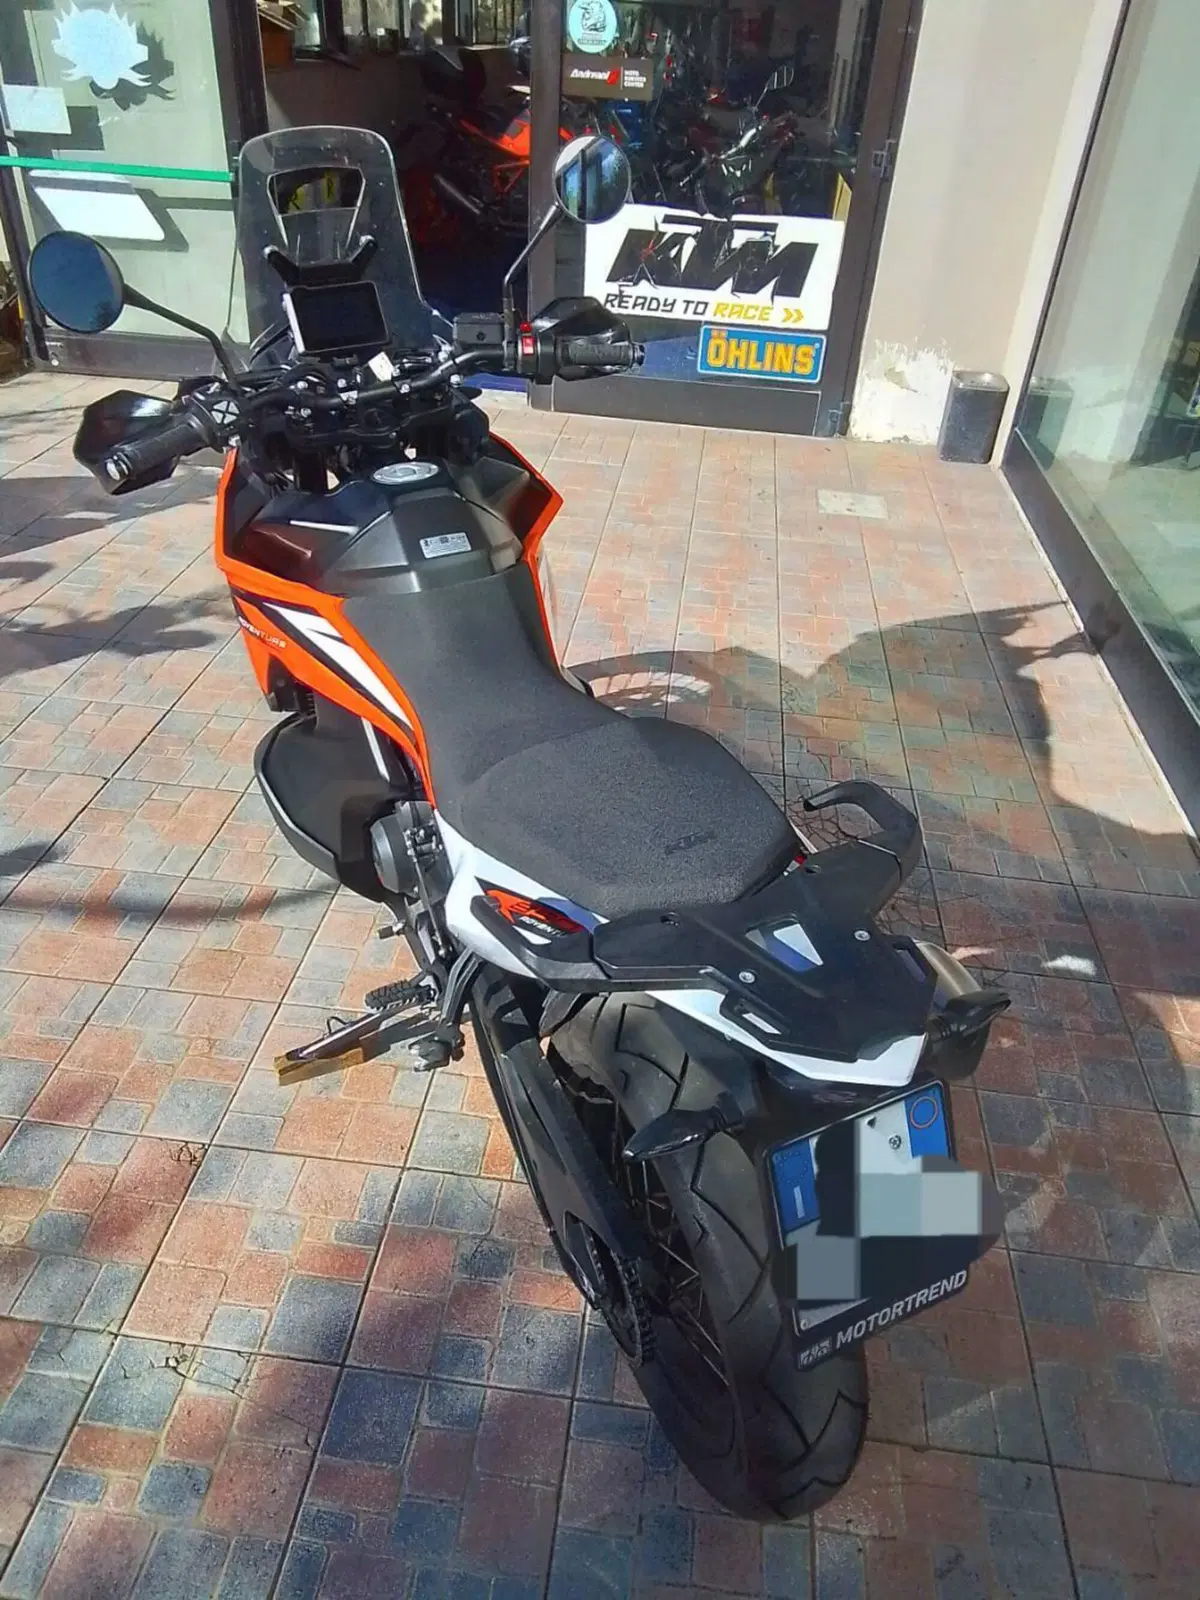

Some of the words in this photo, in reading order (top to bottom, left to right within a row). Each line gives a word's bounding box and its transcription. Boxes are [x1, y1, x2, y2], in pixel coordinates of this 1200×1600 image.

[605, 214, 819, 298] KTM
[603, 293, 677, 313] READY
[682, 299, 710, 316] TO
[712, 301, 774, 321] RACE
[706, 329, 816, 375] ÖHLINS
[836, 1269, 968, 1349] MOTORTREND
